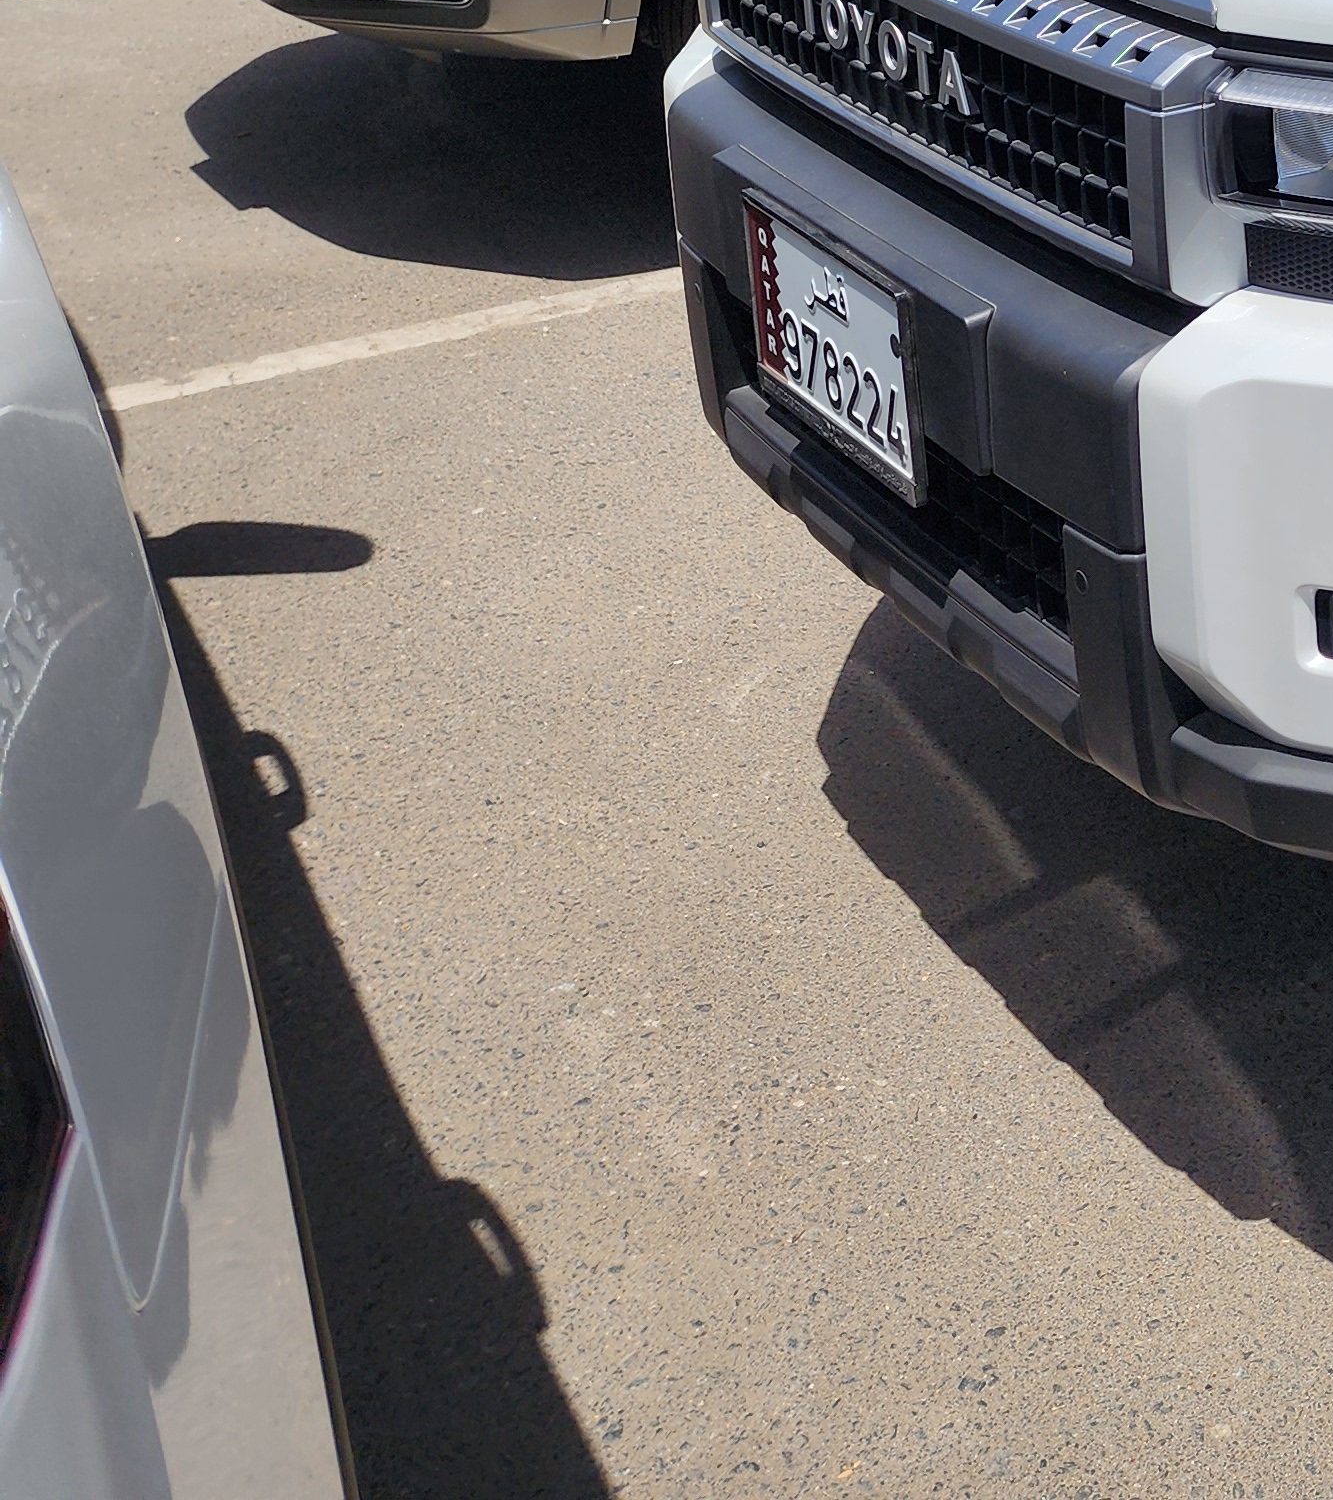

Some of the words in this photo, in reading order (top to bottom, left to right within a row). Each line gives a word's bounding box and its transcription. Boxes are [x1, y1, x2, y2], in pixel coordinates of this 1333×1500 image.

[757, 226, 778, 357] QATAR
[803, 265, 850, 327] قطر
[782, 307, 909, 470] 978224
